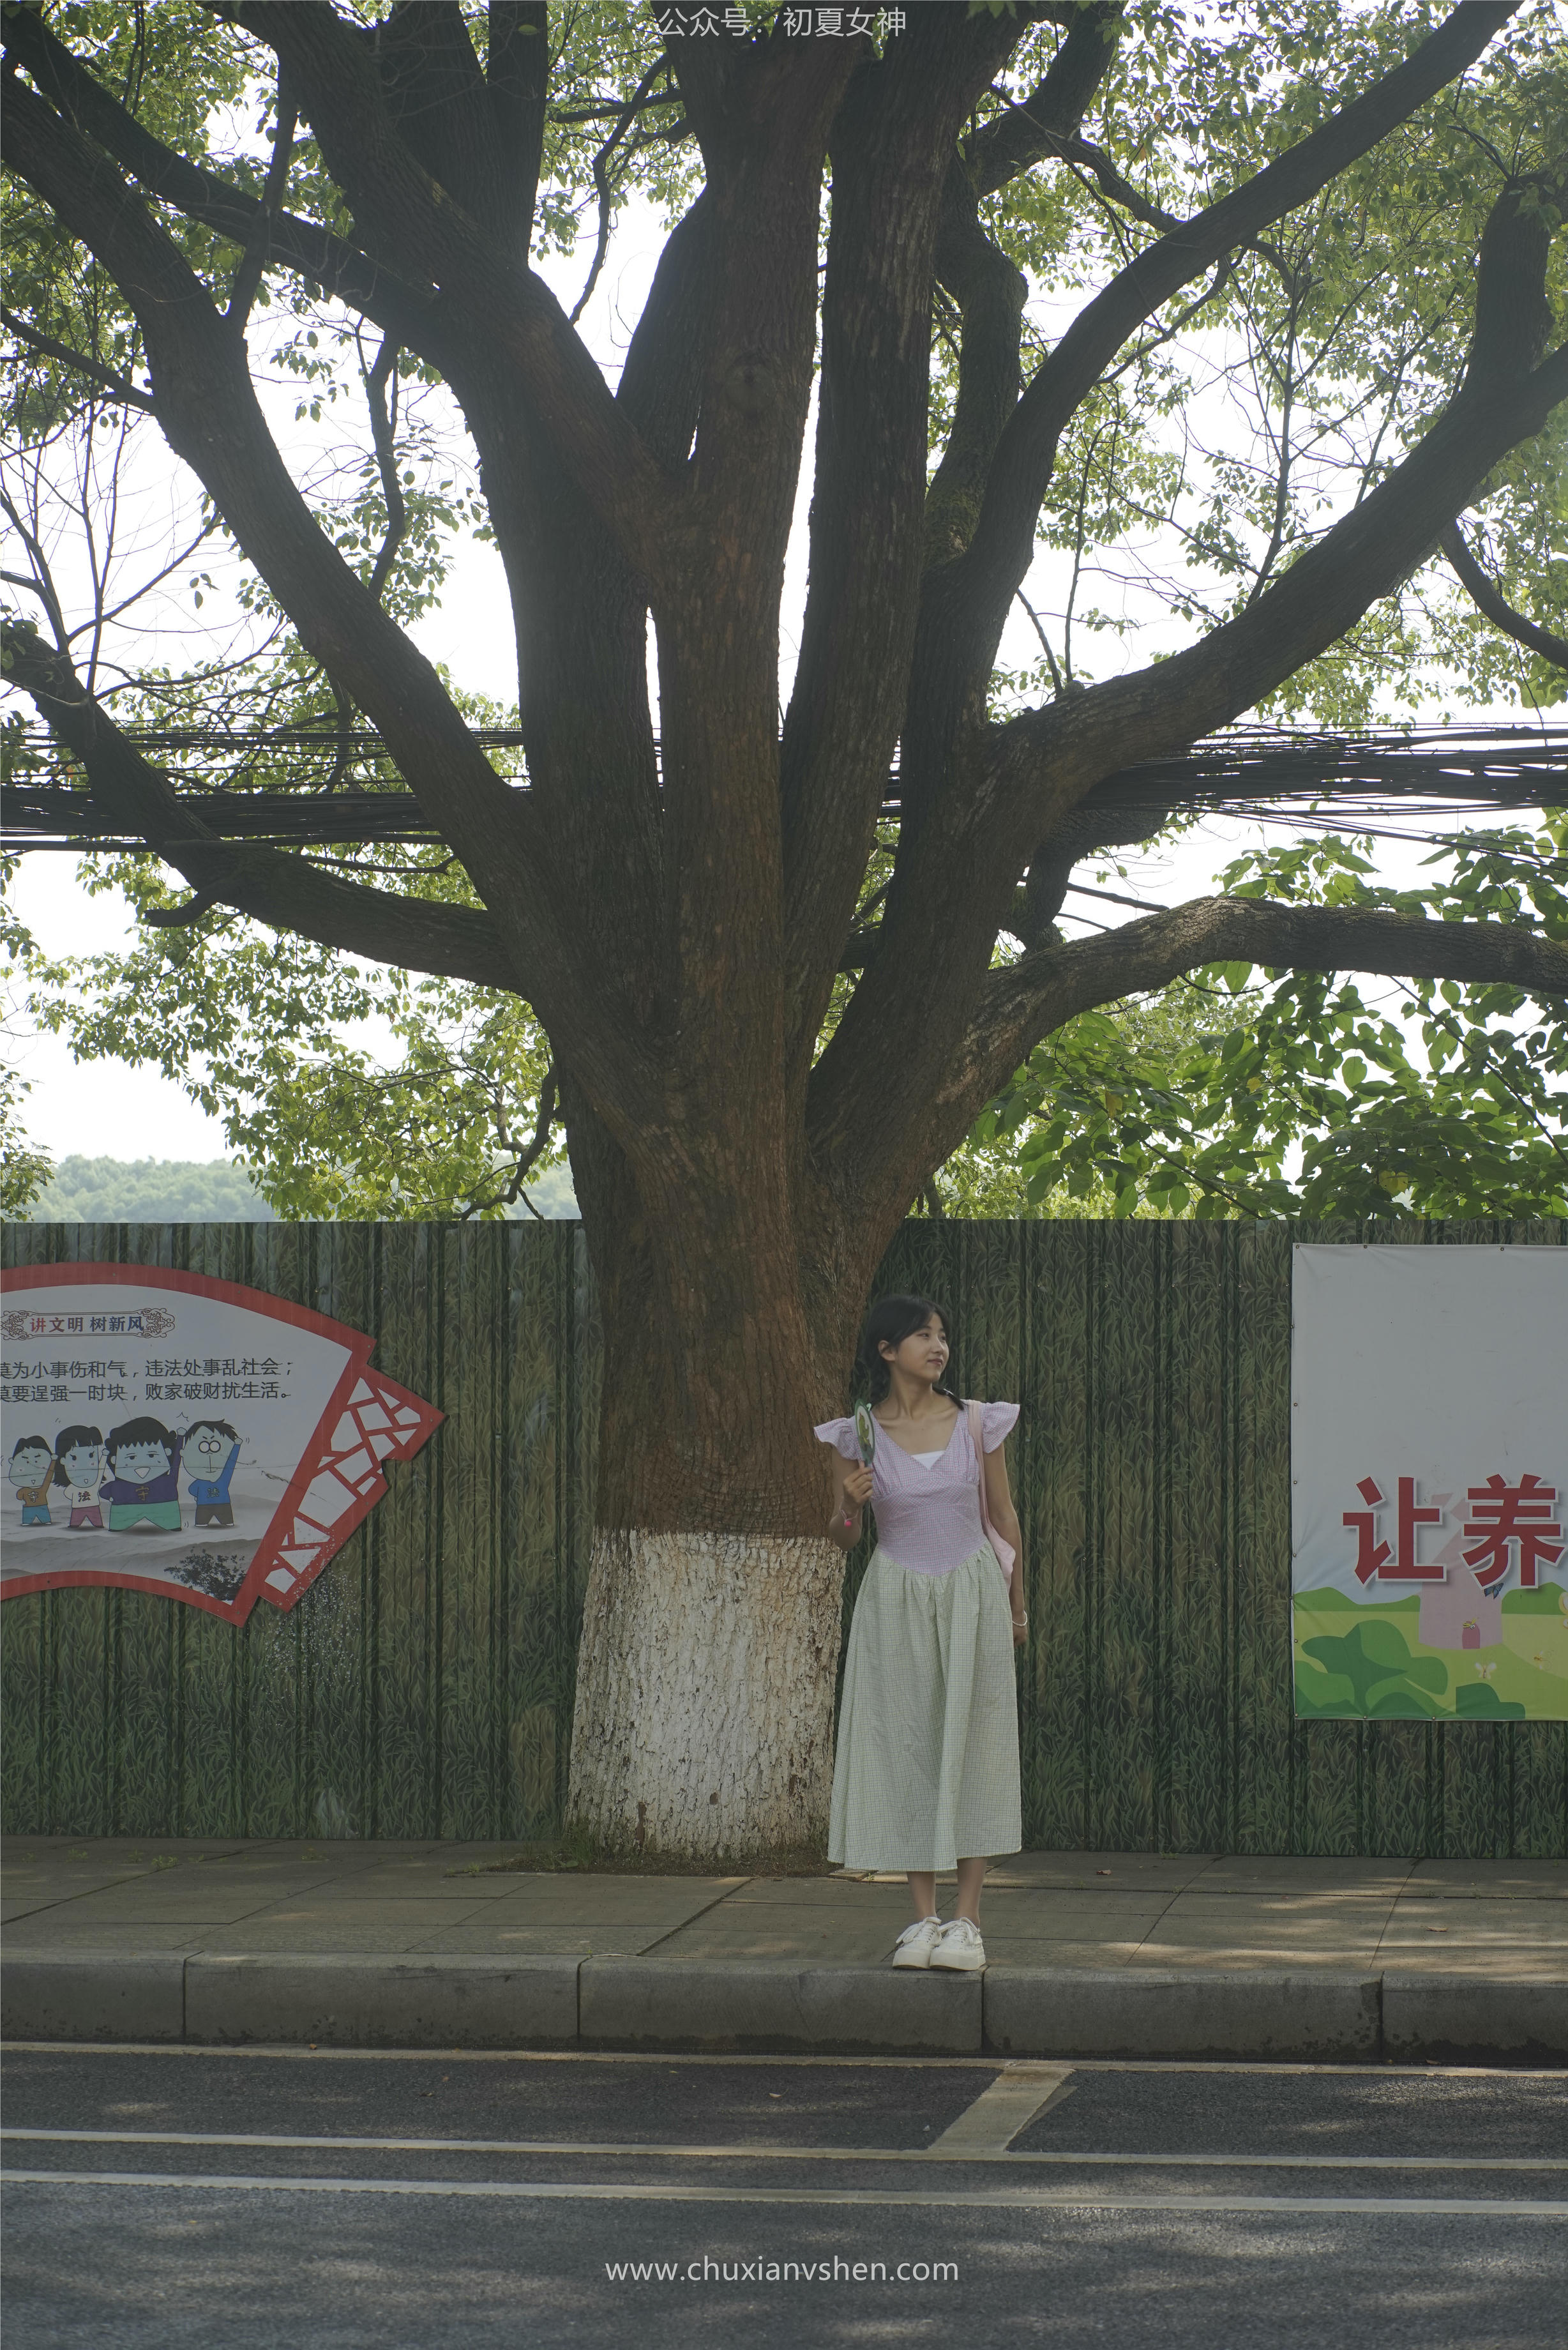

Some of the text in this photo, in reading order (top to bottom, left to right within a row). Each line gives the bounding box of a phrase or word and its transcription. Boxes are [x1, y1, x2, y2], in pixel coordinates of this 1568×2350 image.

[31, 1316, 144, 1333] 讲文明 树新风
[27, 1490, 40, 1503] 守
[78, 1490, 91, 1502] 法
[135, 1486, 150, 1501] 守
[207, 1487, 220, 1499] 法
[1343, 1474, 1565, 1588] 让养
